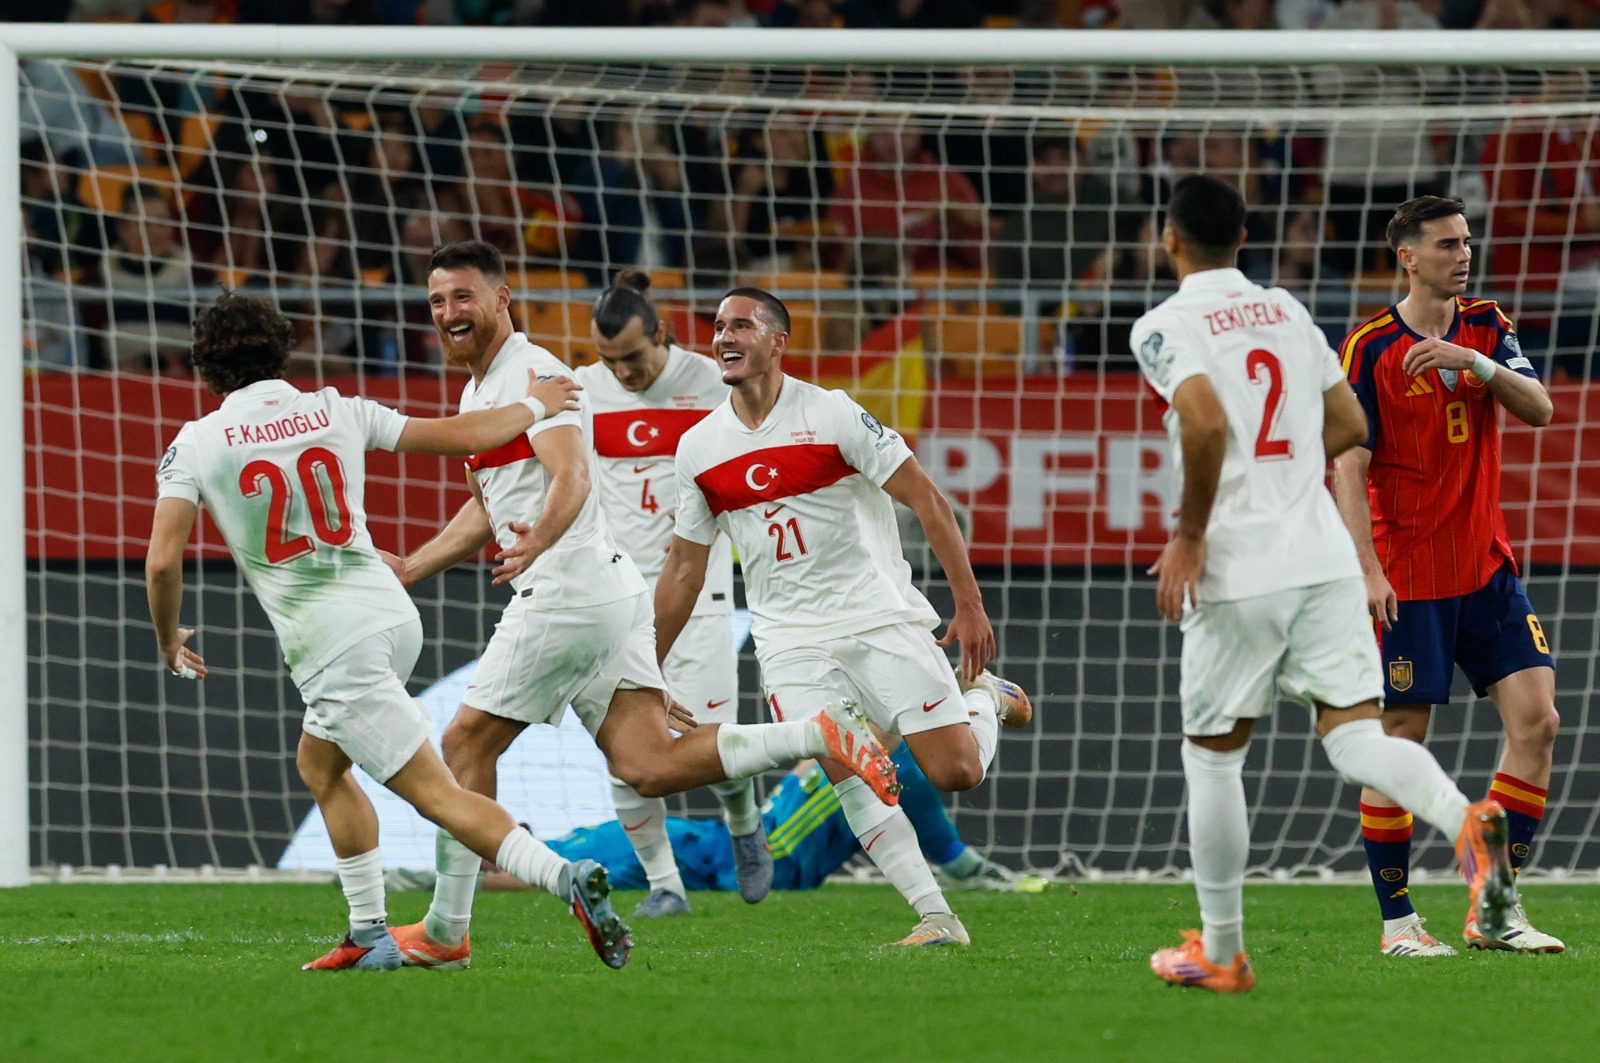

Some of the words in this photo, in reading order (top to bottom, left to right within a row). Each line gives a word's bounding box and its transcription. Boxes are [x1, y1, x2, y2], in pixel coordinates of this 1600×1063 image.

[1246, 348, 1294, 462] 2
[1446, 401, 1469, 443] 8
[224, 408, 330, 447] F.KADIOĞLU
[239, 447, 356, 565] 20
[641, 479, 658, 514] 4
[768, 517, 808, 562] 21
[1526, 614, 1550, 655] 8
